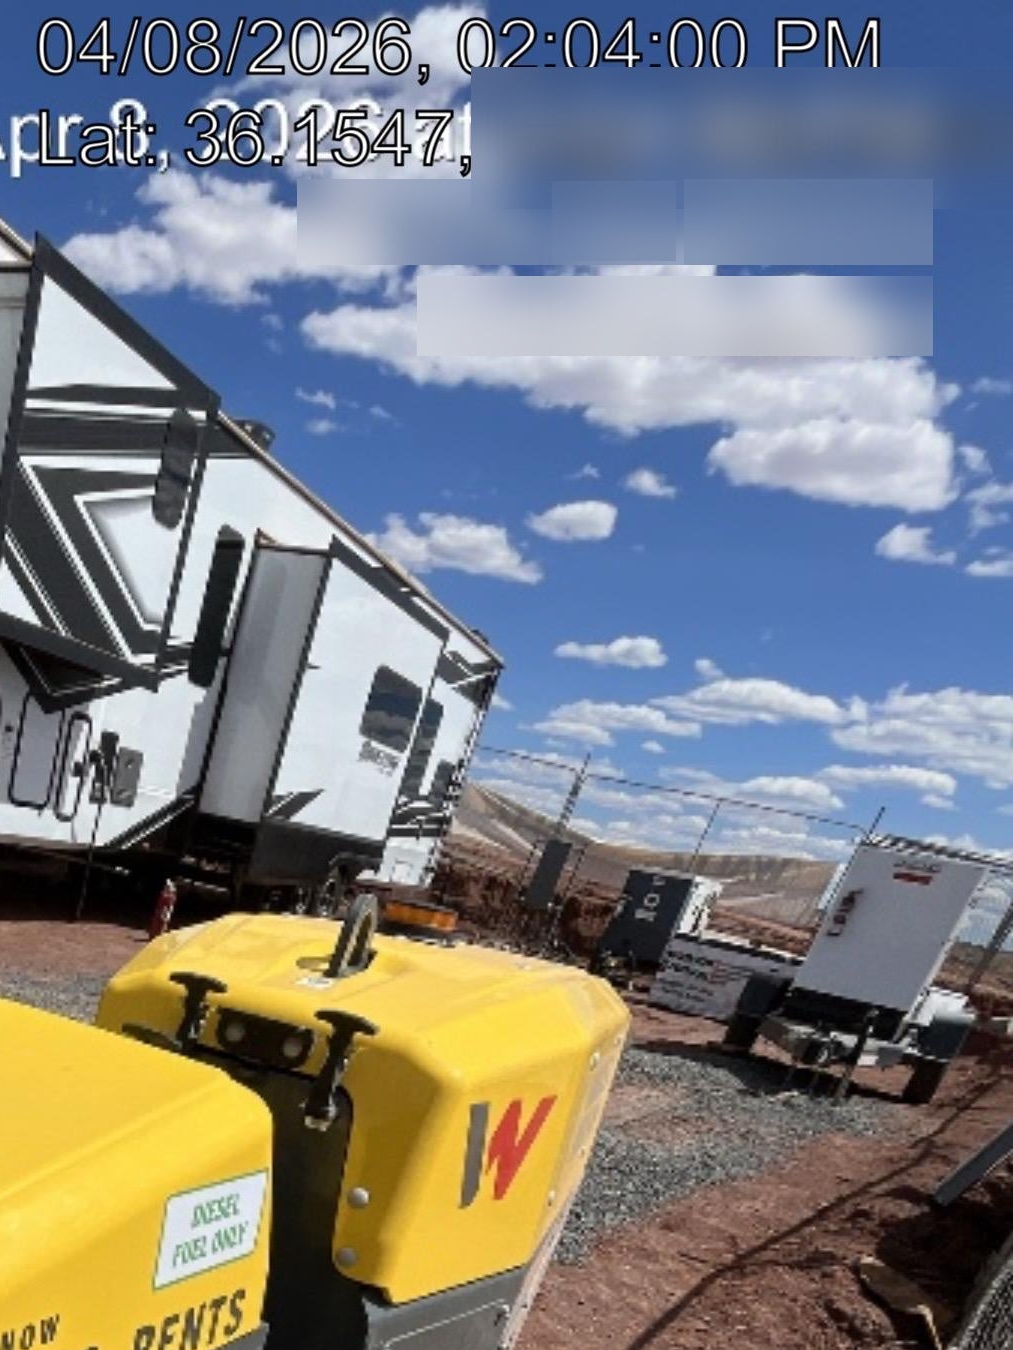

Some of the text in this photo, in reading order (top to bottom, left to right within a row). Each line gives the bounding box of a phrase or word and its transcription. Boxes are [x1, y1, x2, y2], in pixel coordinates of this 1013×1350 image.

[190, 1192, 240, 1230] DIESEL
[171, 1219, 250, 1269] FUEL ONLY
